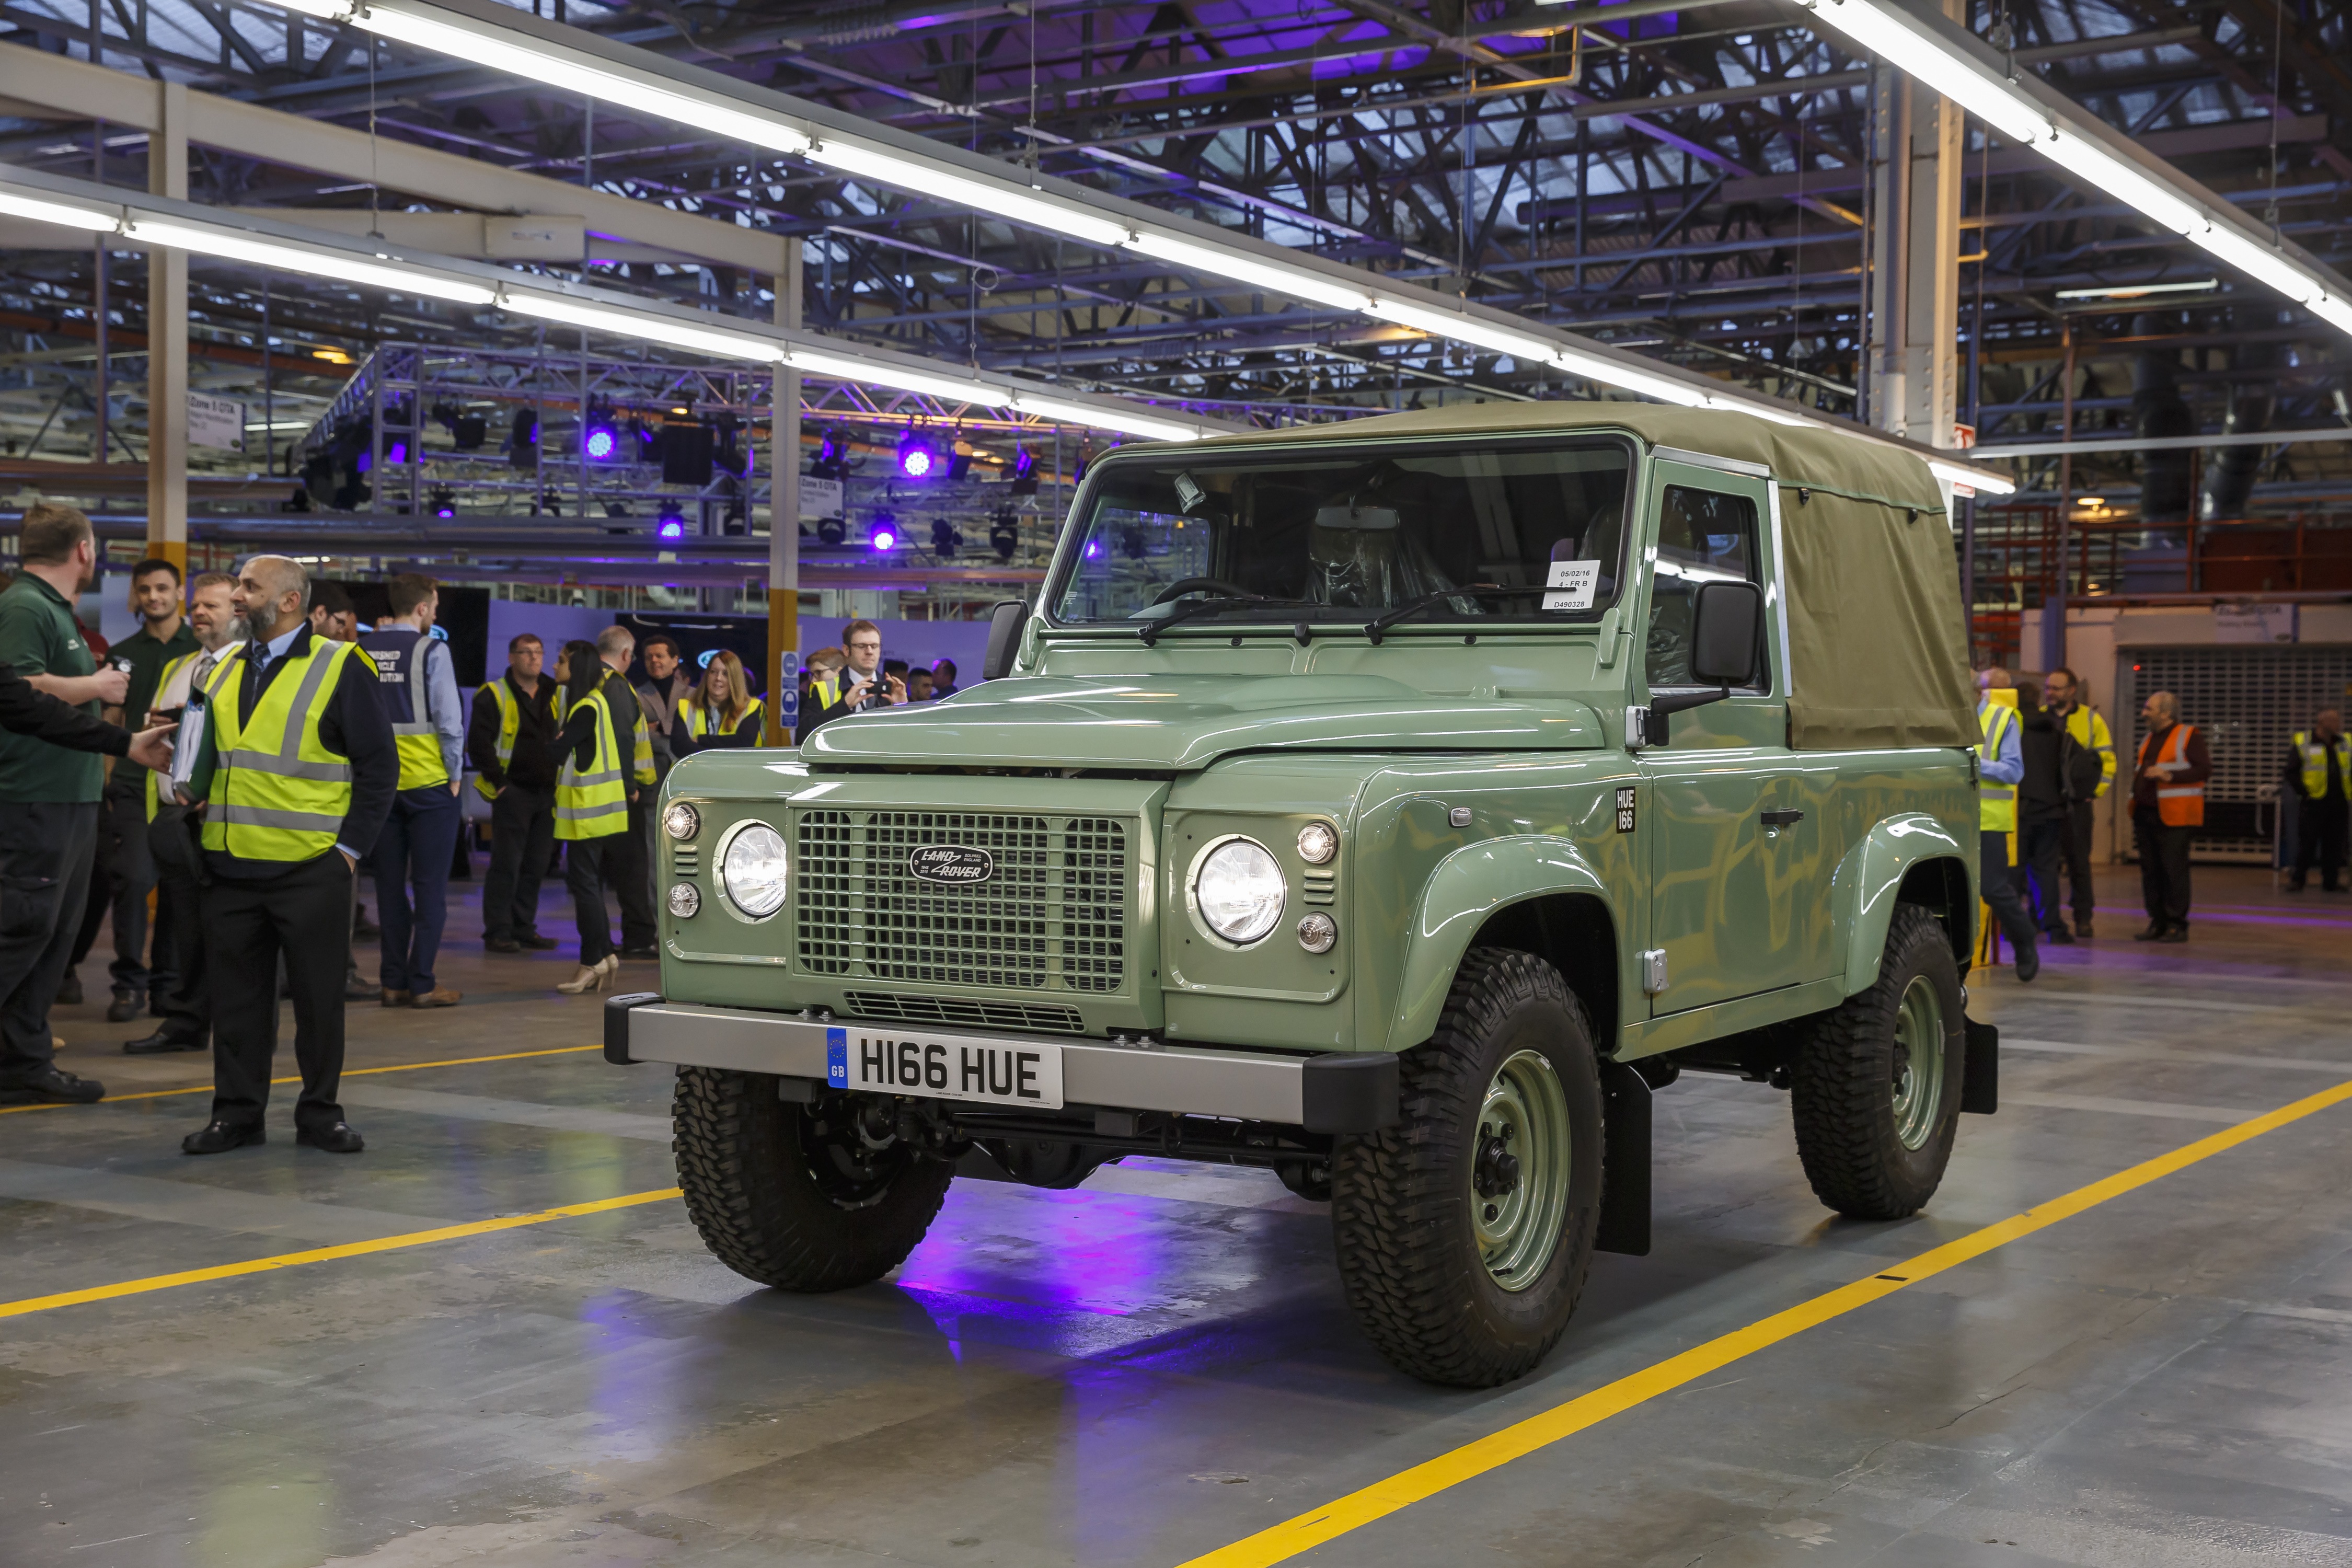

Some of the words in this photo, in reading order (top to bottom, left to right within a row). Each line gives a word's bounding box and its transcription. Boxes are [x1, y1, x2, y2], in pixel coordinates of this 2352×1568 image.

[1617, 789, 1634, 809] HUE
[1619, 810, 1633, 829] 166
[921, 850, 954, 861] LAND
[939, 866, 982, 878] ROVER
[831, 1065, 845, 1078] GB
[961, 1046, 1041, 1099] HUE
